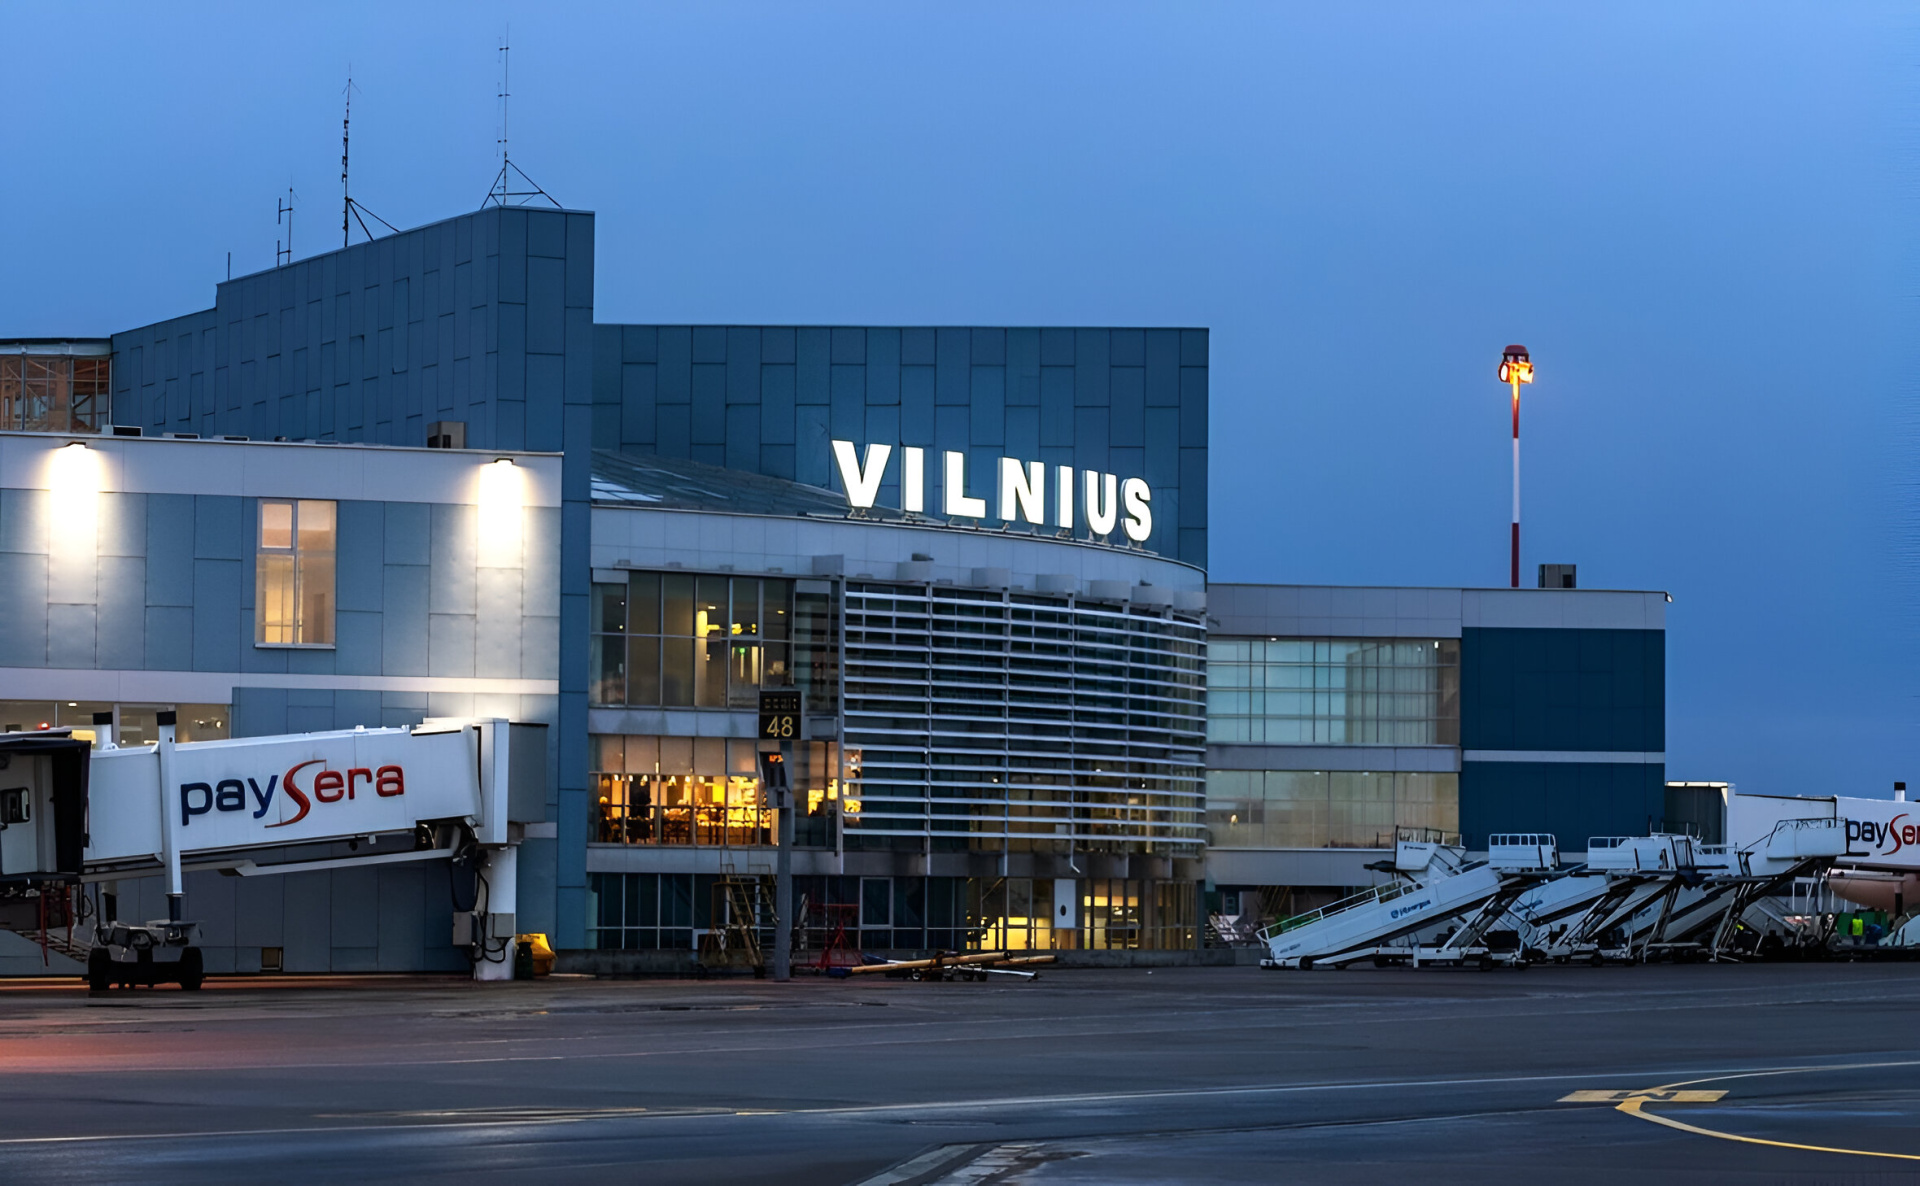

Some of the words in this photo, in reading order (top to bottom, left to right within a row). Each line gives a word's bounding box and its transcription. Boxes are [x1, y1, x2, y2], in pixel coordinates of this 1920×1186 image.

[831, 440, 1152, 542] VILNIUS
[767, 715, 793, 737] 48
[1845, 813, 1920, 856] paySe
